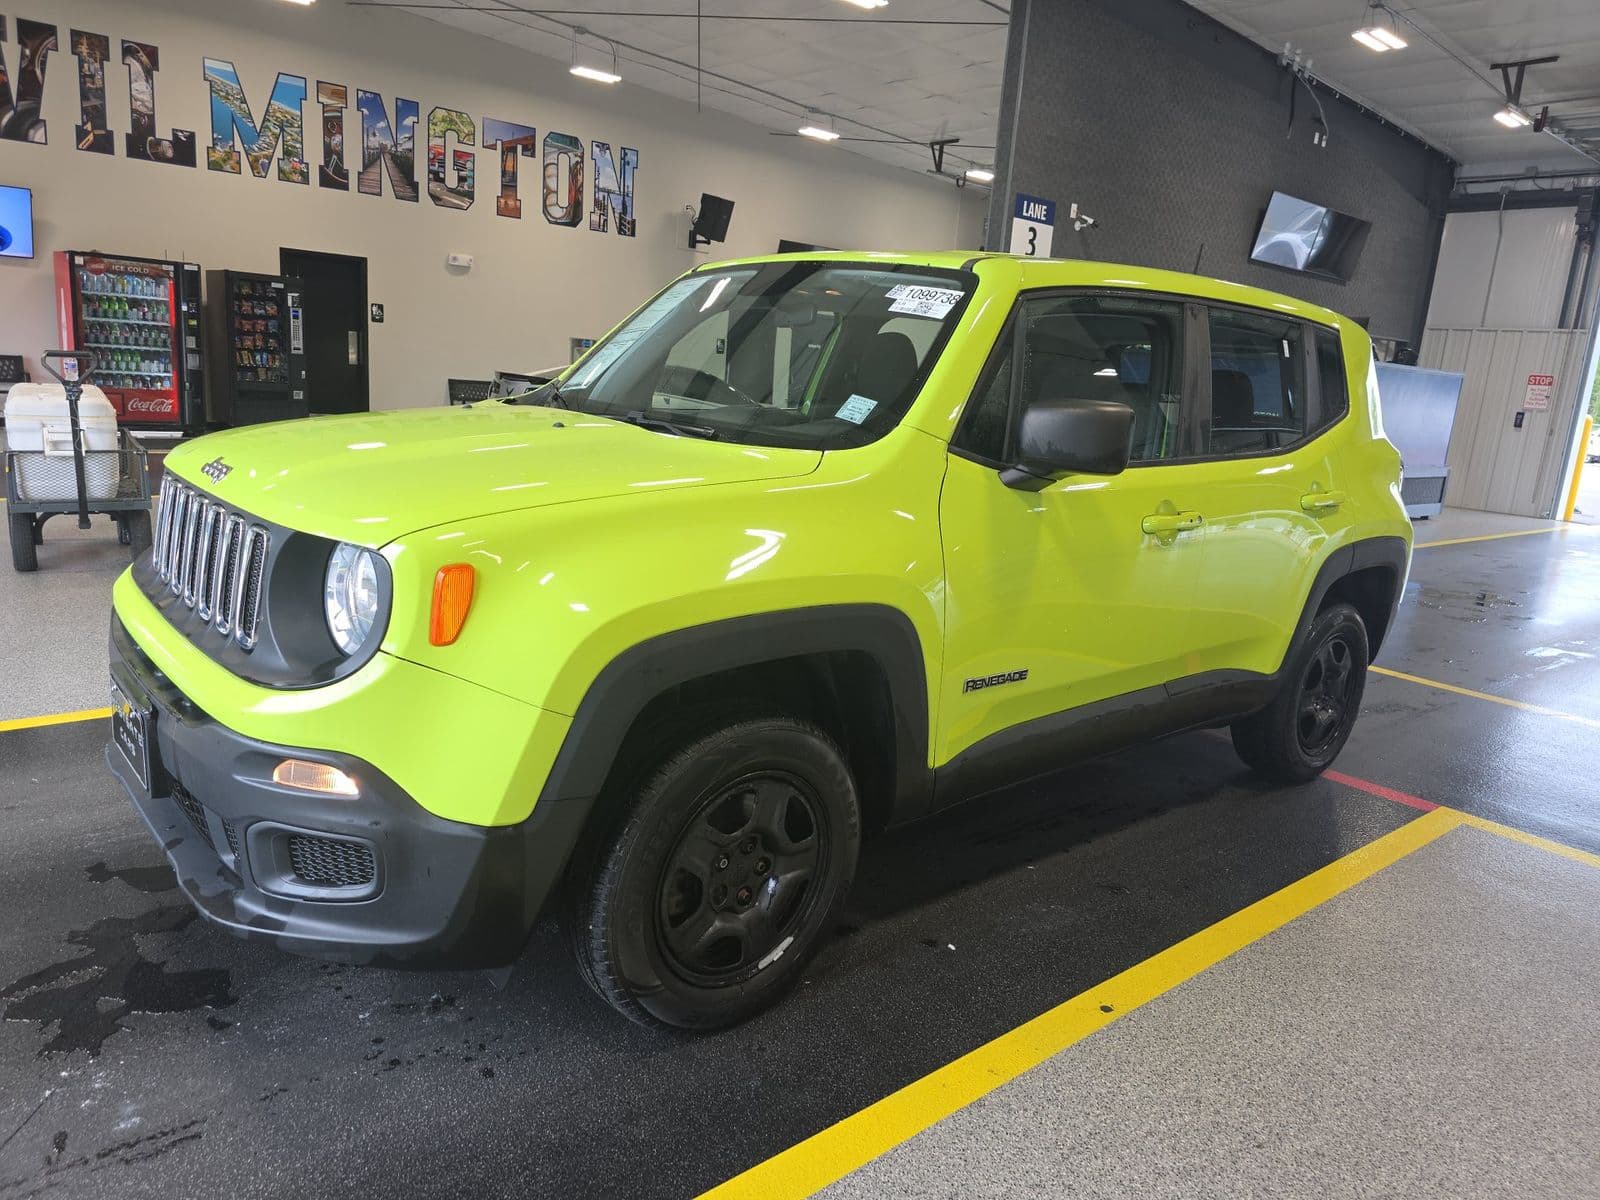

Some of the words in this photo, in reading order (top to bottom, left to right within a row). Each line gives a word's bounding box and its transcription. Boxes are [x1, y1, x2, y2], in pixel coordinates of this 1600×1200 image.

[1023, 200, 1047, 220] LANE
[1025, 226, 1037, 256] 3
[127, 266, 149, 274] COLD
[906, 288, 961, 305] 1099738
[1529, 376, 1553, 385] STOP
[963, 669, 1029, 694] RENEGADE
